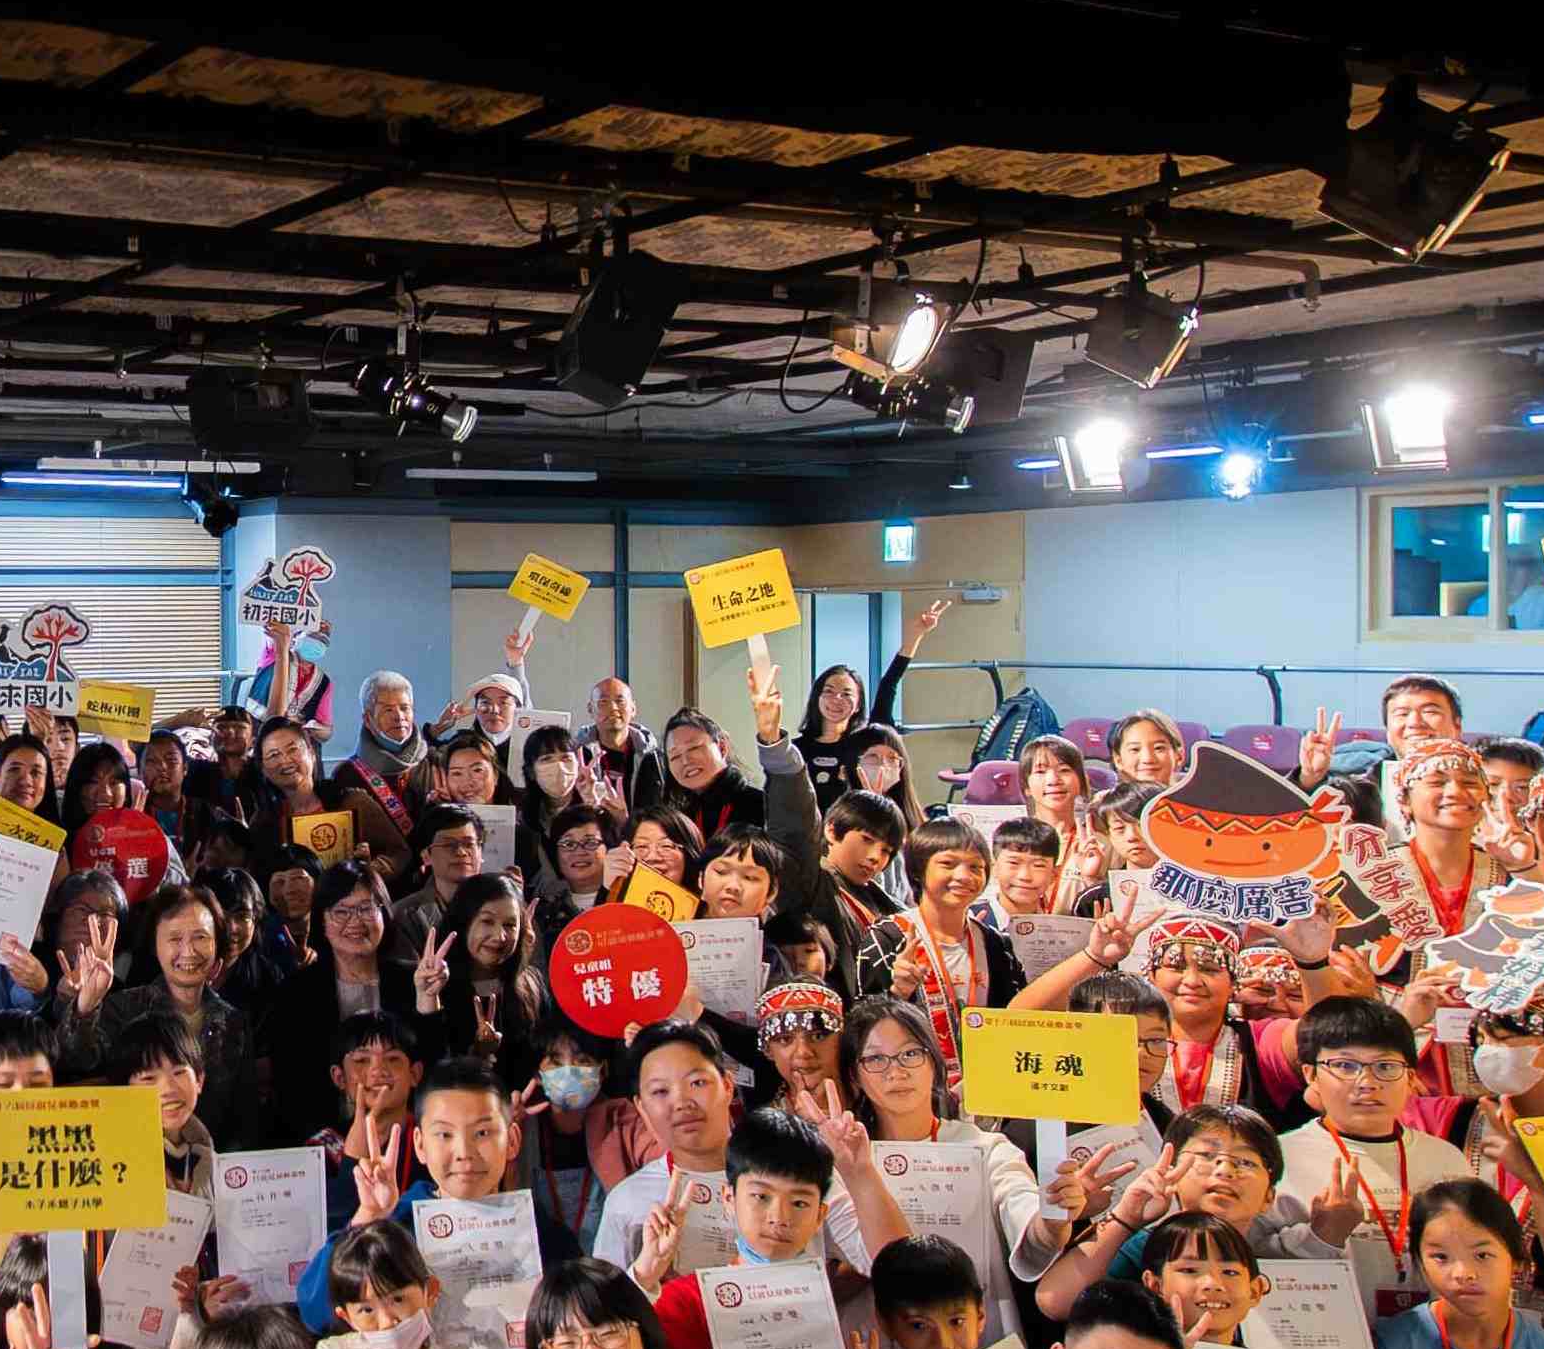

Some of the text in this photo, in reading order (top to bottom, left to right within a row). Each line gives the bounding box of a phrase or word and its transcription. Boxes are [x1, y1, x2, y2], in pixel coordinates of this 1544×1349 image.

[712, 582, 776, 611] 生命之地
[243, 604, 317, 625] 初來國小
[1153, 863, 1313, 920] 那麼厲害
[582, 968, 661, 1008] 特優
[27, 1124, 95, 1155] 黑黑
